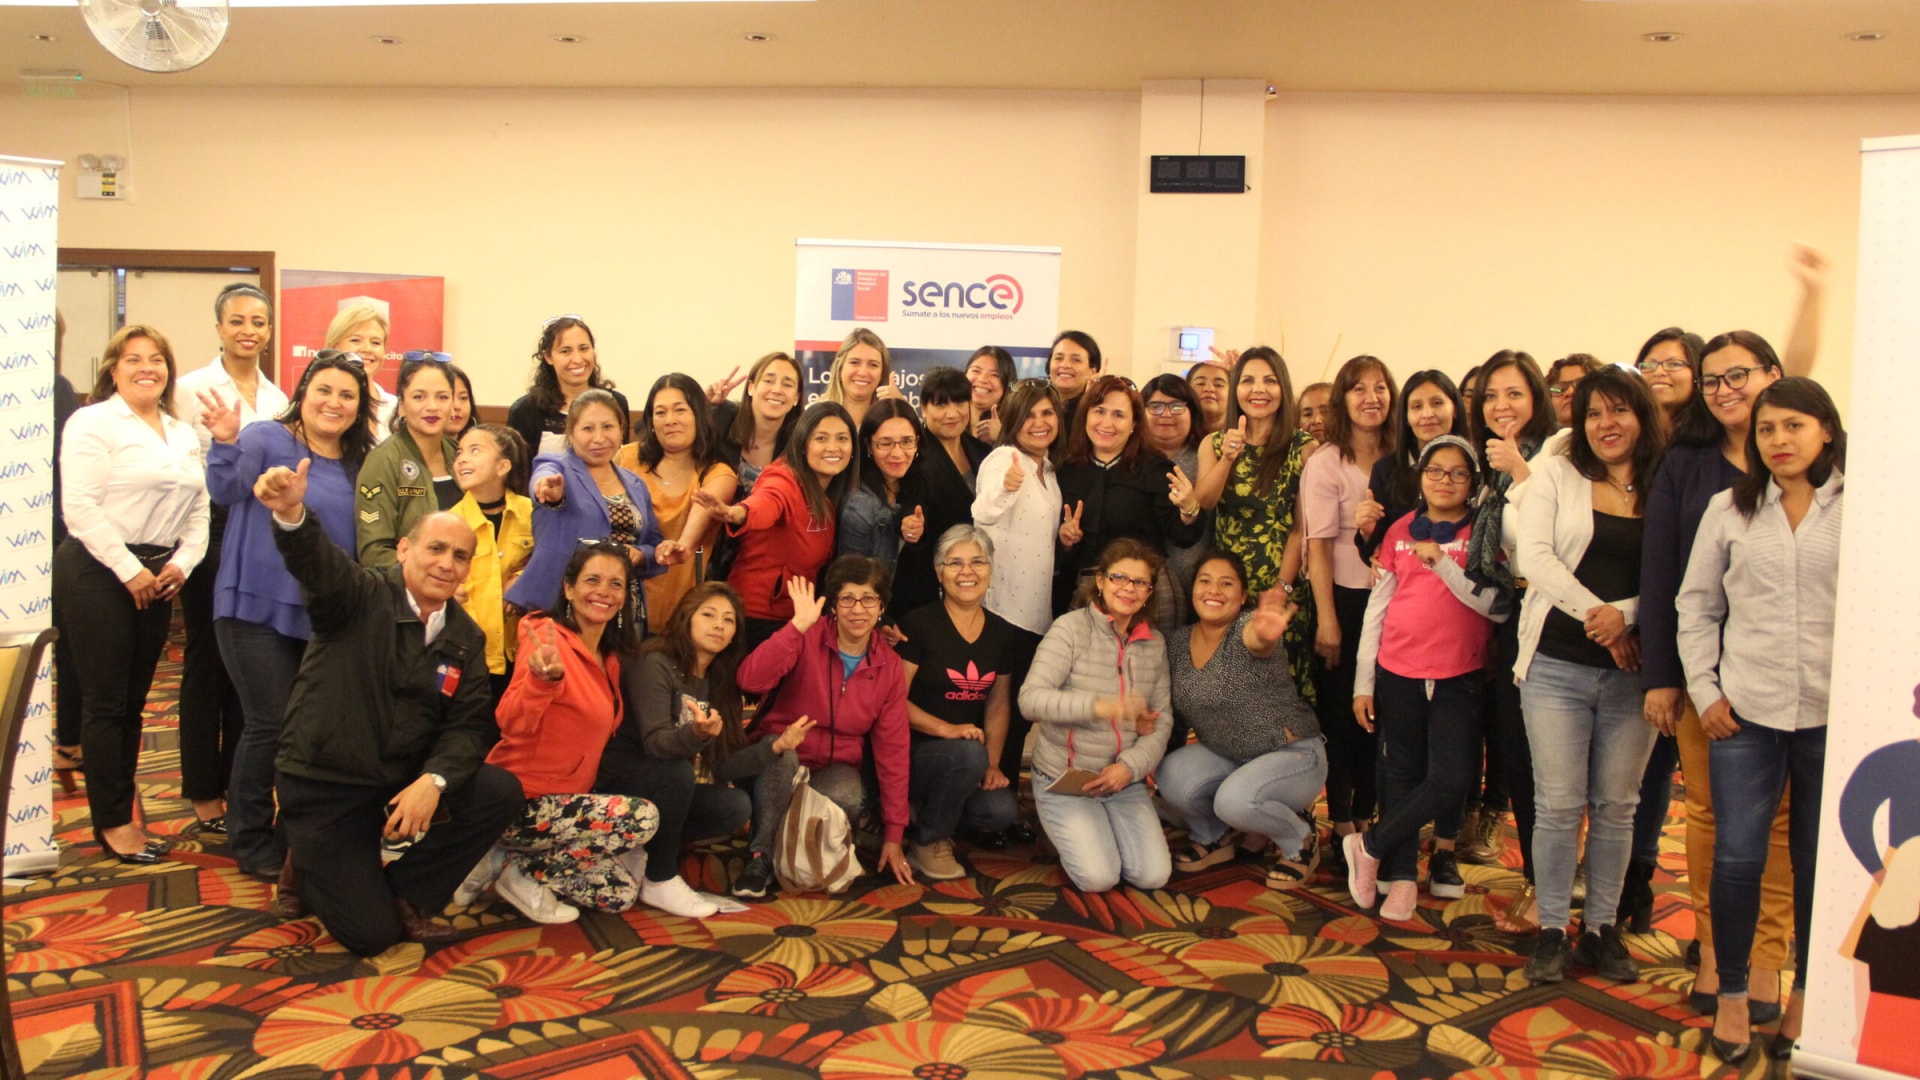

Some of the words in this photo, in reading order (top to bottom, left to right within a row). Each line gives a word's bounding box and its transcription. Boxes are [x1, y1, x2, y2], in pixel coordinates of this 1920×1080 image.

[902, 280, 1015, 310] sence
[902, 309, 931, 318] Súmate
[939, 310, 951, 318] los
[980, 312, 1013, 321] empleos
